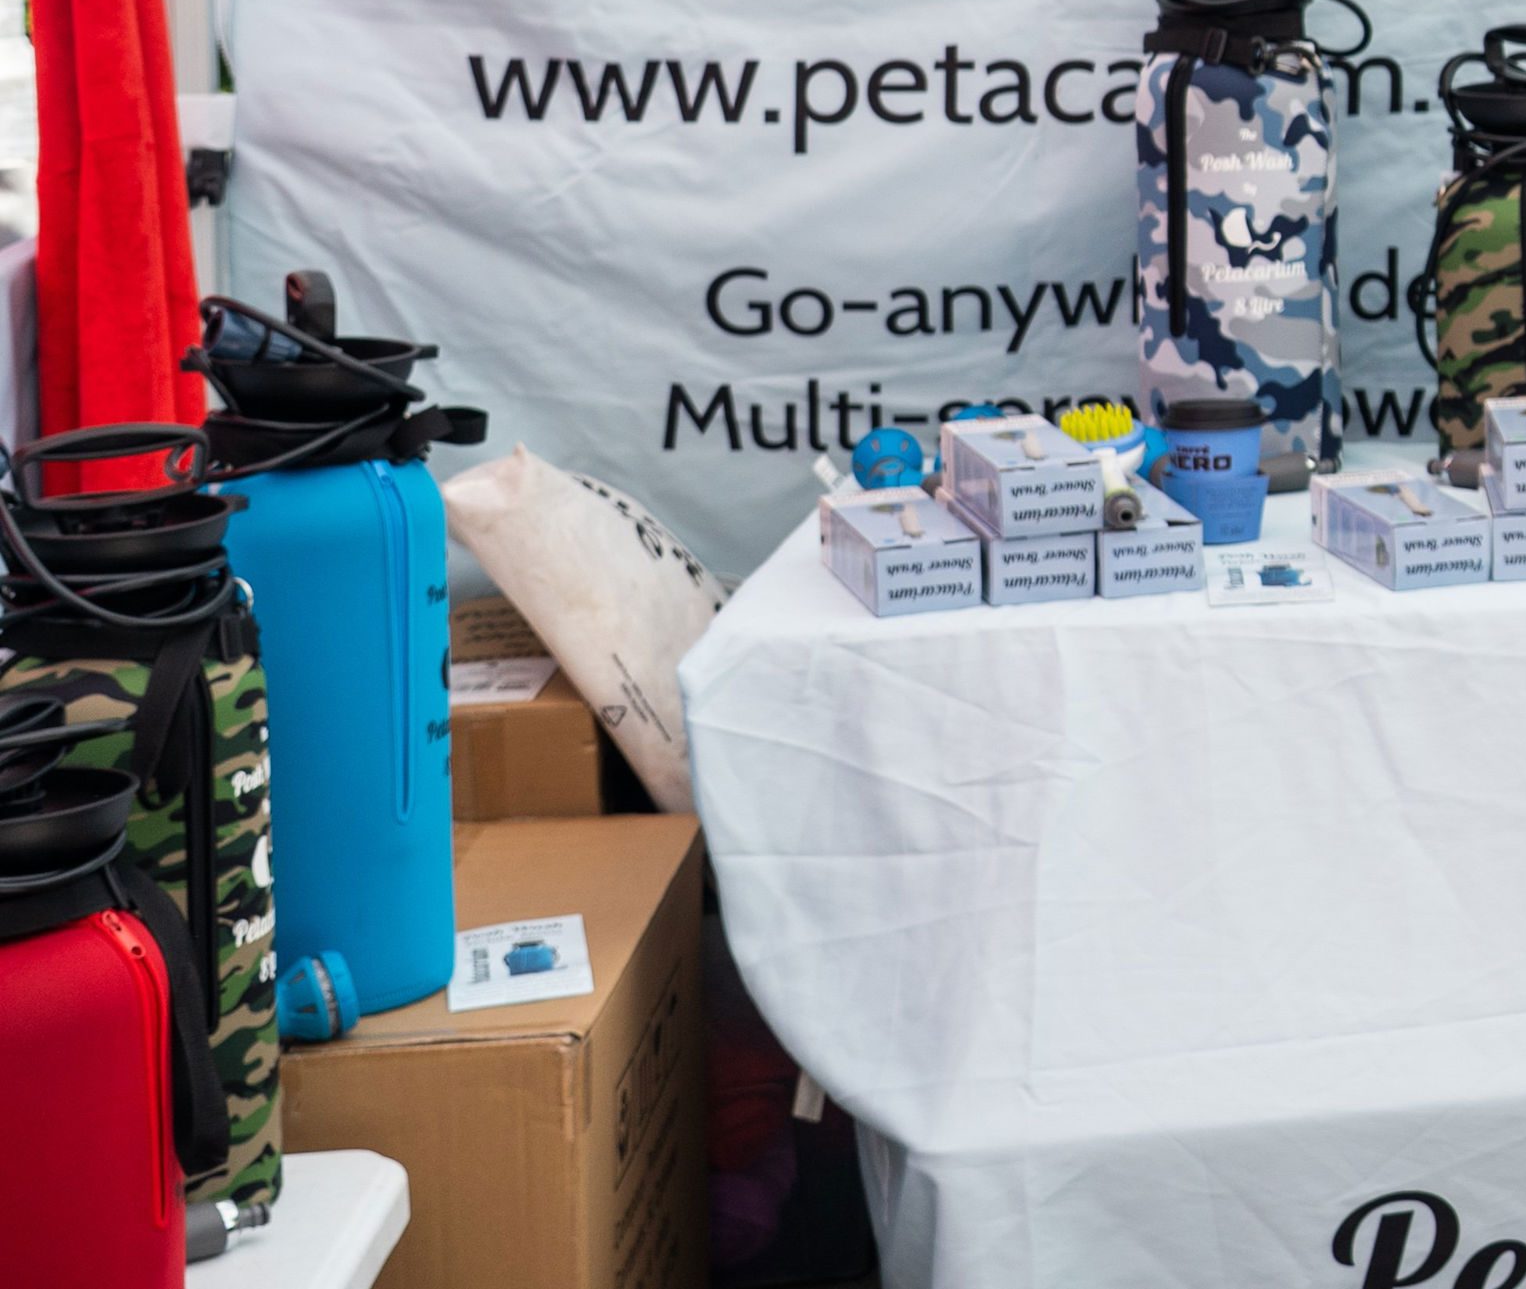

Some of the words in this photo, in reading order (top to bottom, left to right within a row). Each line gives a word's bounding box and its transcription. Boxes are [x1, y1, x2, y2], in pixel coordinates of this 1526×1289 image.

[1010, 483, 1049, 498] Brush
[1051, 477, 1096, 492] Shower
[1151, 540, 1196, 555] Shower
[1403, 539, 1437, 553] Brush
[1441, 533, 1484, 547] Shower
[1002, 551, 1041, 566] Brush
[1043, 547, 1088, 561] Shower
[1112, 544, 1149, 560] Brush
[886, 562, 925, 578] Brush
[928, 557, 974, 573] Shower
